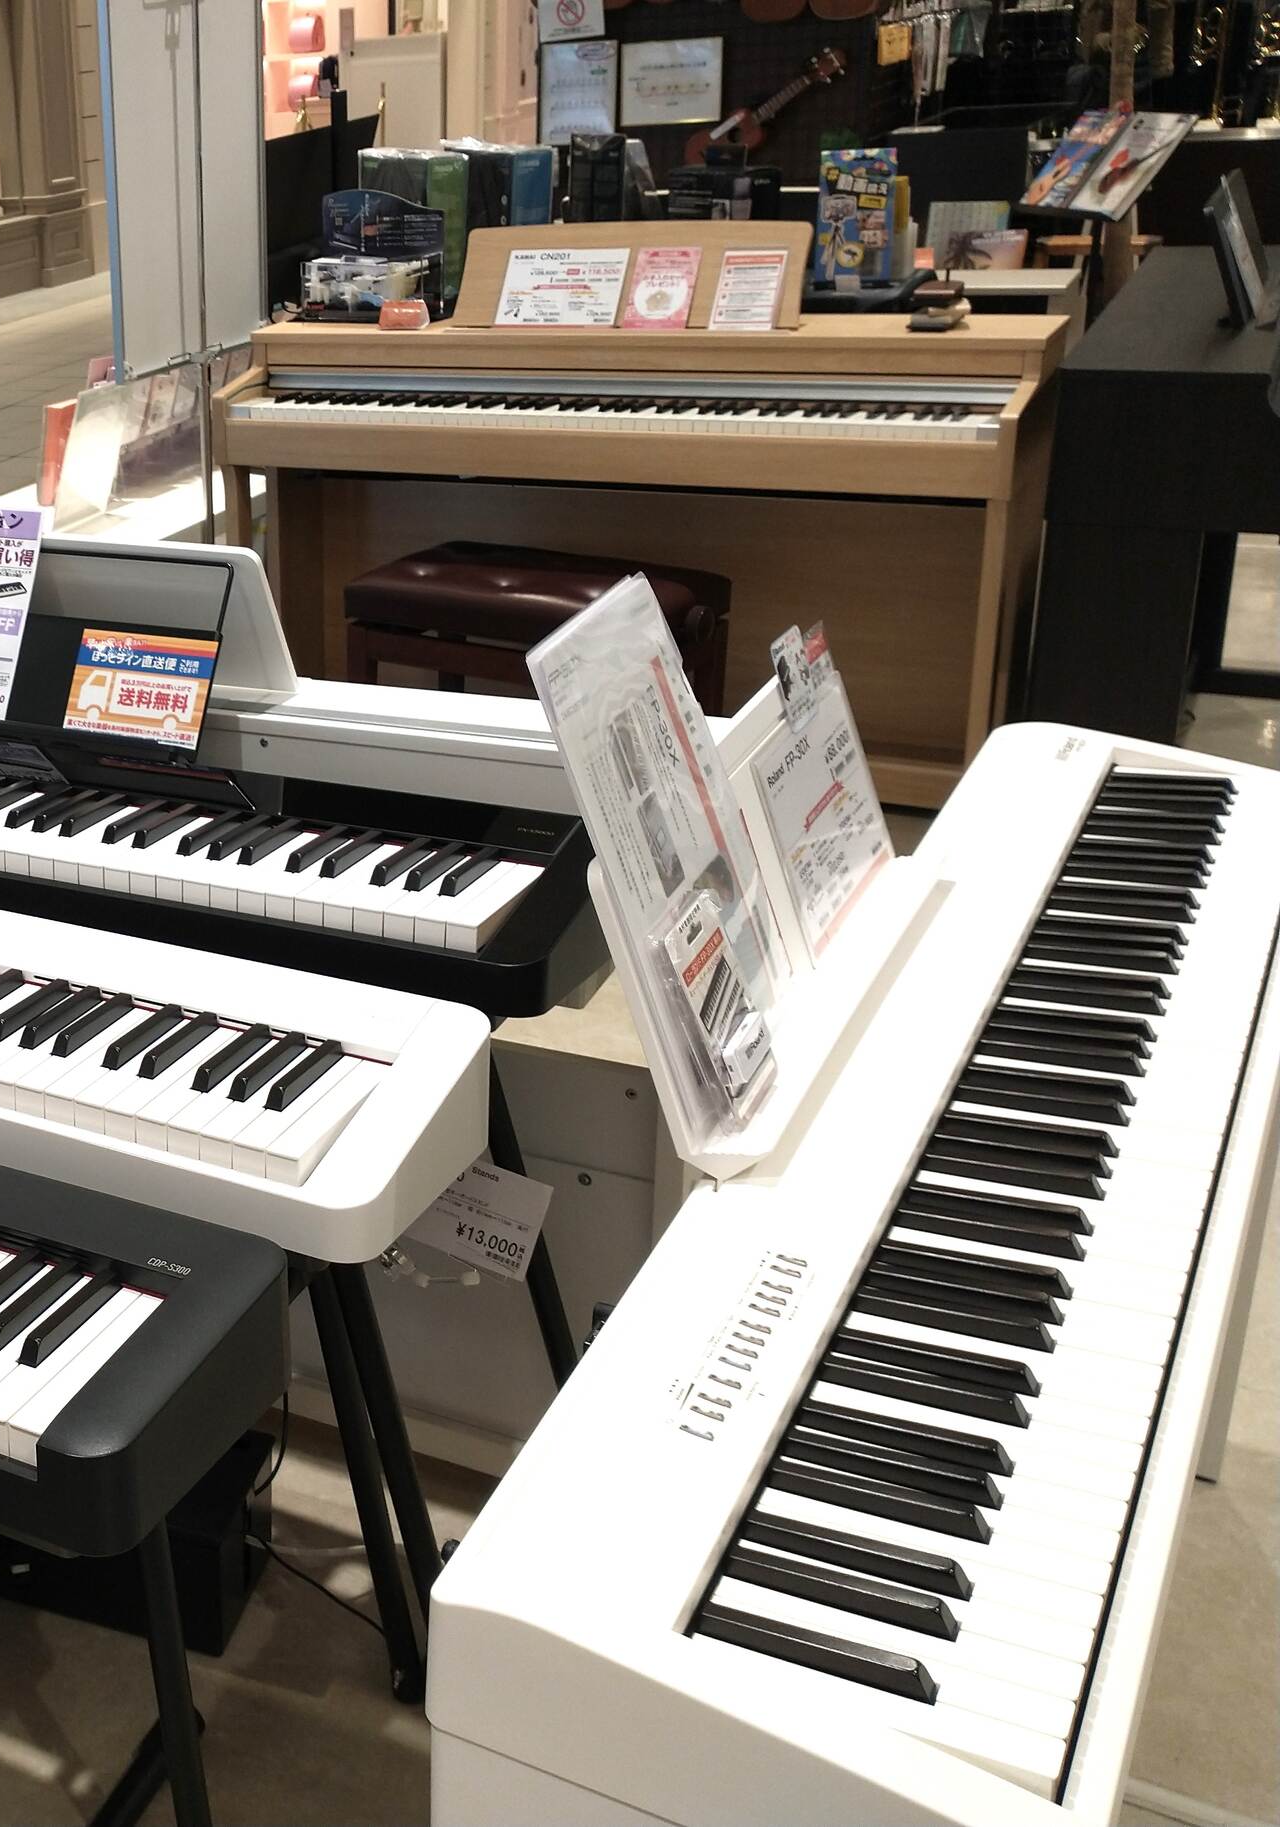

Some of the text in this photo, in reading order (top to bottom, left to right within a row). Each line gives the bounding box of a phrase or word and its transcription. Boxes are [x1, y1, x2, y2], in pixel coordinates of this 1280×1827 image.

[540, 252, 571, 261] CN201
[117, 687, 189, 713] 送料無料
[645, 683, 681, 768] FP-30X
[767, 735, 811, 790] Roland FP-30X
[471, 1166, 500, 1183] Stands
[455, 1221, 518, 1257] ¥13,000
[147, 1257, 192, 1276] CDP-S300
